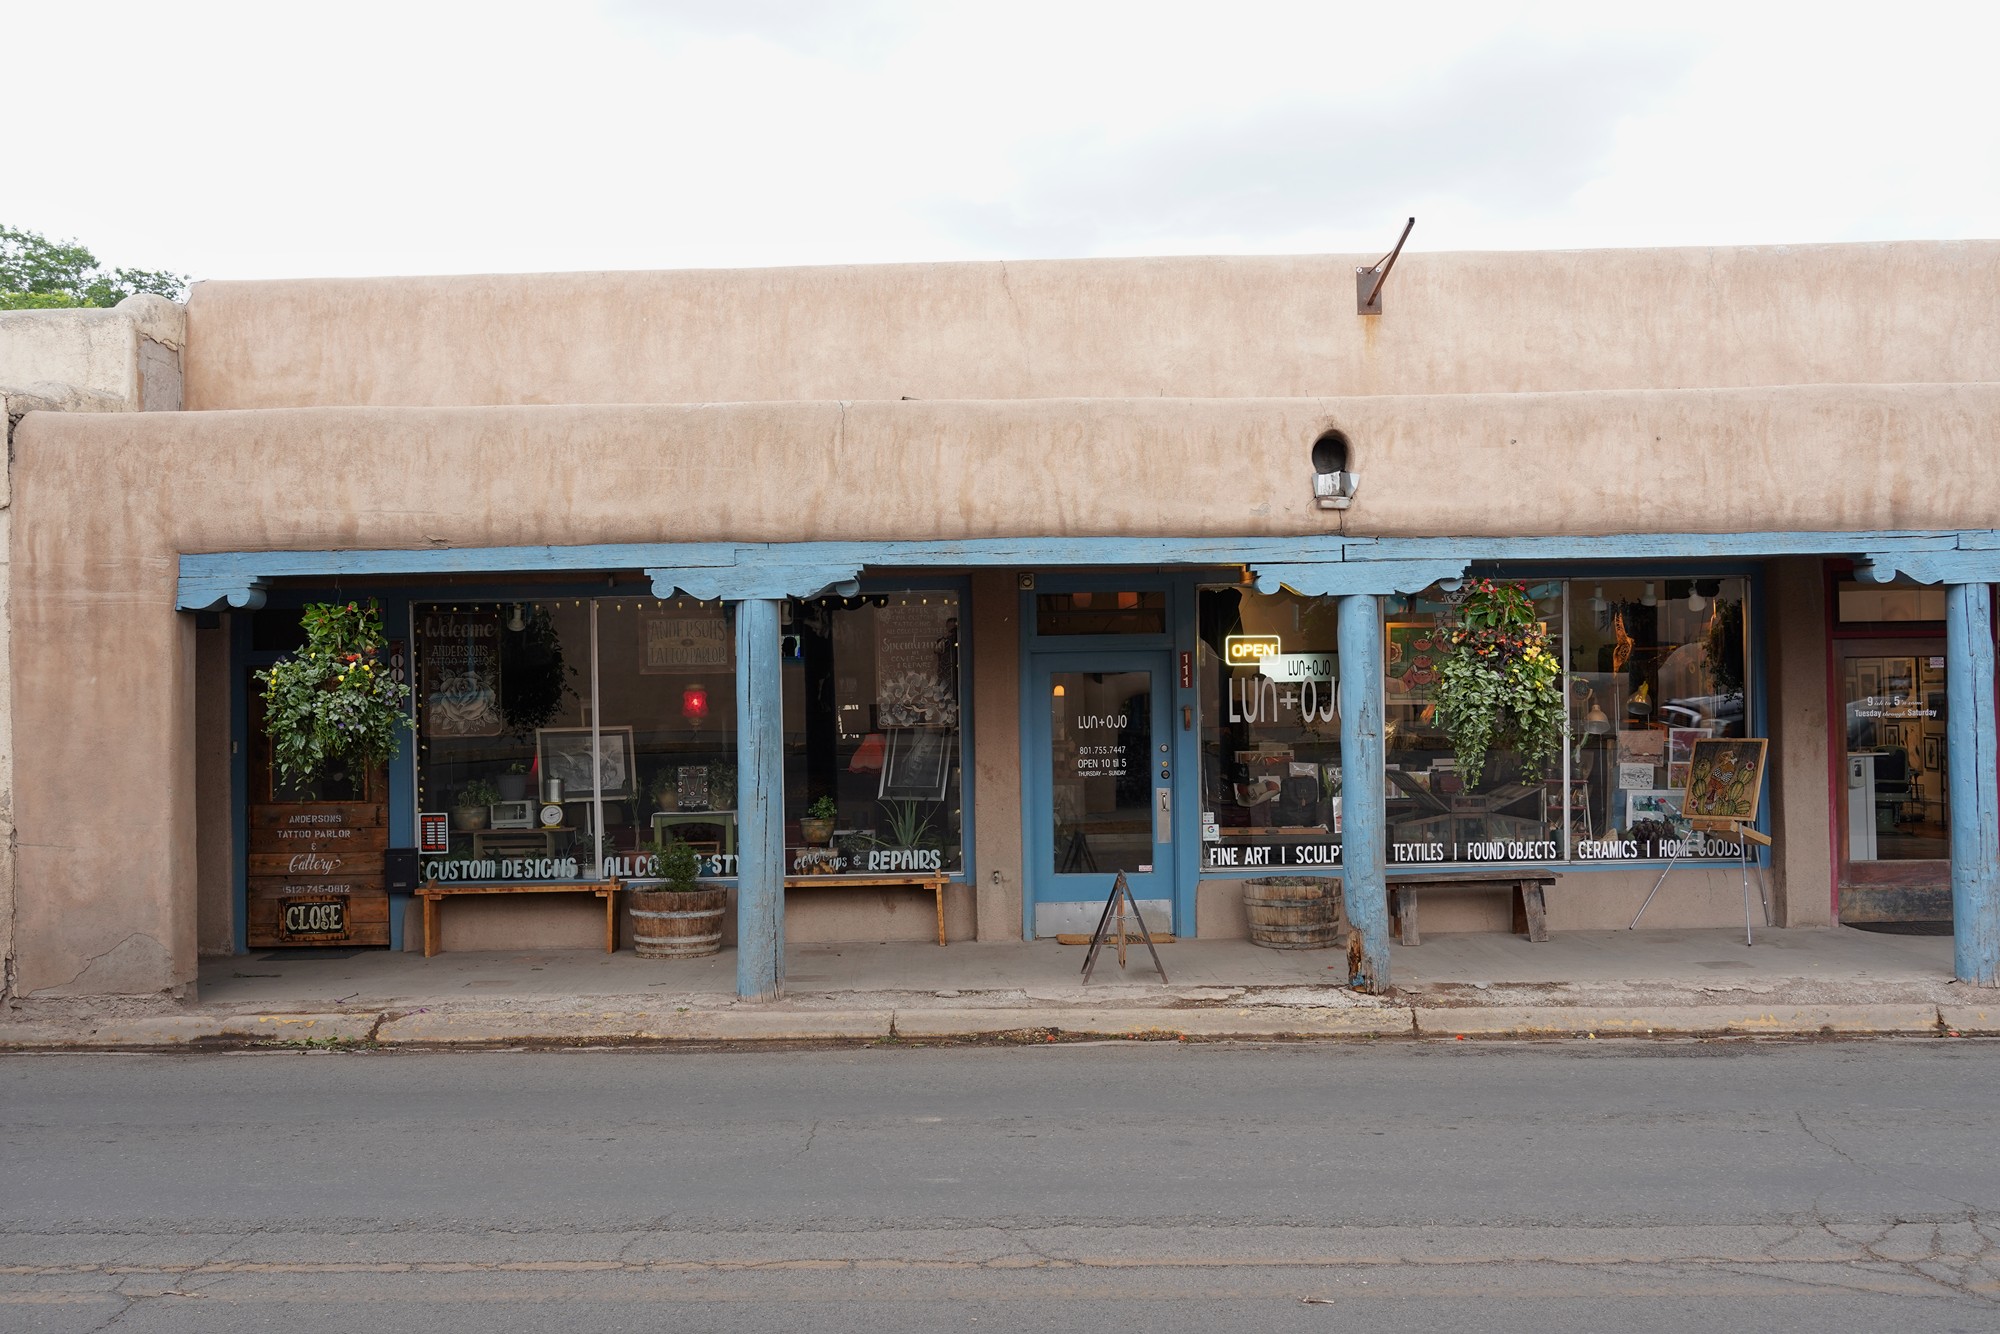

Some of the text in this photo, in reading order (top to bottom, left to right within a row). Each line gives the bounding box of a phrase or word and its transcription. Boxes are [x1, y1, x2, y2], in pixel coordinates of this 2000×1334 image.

[426, 614, 497, 638] Welcome
[432, 645, 488, 656] ANDERSONS
[650, 648, 688, 664] TATTOO
[1231, 643, 1275, 657] OPEN
[425, 656, 497, 666] TATTOO PARLOR
[1867, 696, 1873, 706] 9
[1894, 696, 1900, 706] 5
[1854, 709, 1882, 718] Tuesday
[1907, 709, 1936, 718] Saturday
[1079, 746, 1126, 755] 801.755.7447
[1078, 759, 1098, 768] OPEN
[1101, 759, 1110, 768] 10
[1121, 758, 1127, 768] 5
[289, 815, 341, 824] ANDERSONS
[277, 830, 350, 838] TATTOO PARLOR
[1210, 847, 1238, 866] FINE
[1244, 846, 1271, 865] ART
[1296, 845, 1342, 864] SCULP
[1393, 842, 1444, 861] TEXTILES
[1468, 842, 1505, 861] FOUND
[1508, 840, 1556, 860] OBJECTS
[1578, 840, 1638, 859] CERAMICS
[1659, 839, 1693, 857] HOME
[1699, 838, 1741, 857] GOODS
[289, 853, 341, 875] Gallery
[603, 856, 632, 876] ALL
[829, 857, 847, 870] ups
[868, 849, 941, 870] REPAIRS
[502, 857, 578, 879] DESIGNS
[286, 904, 343, 930] CLOSE
